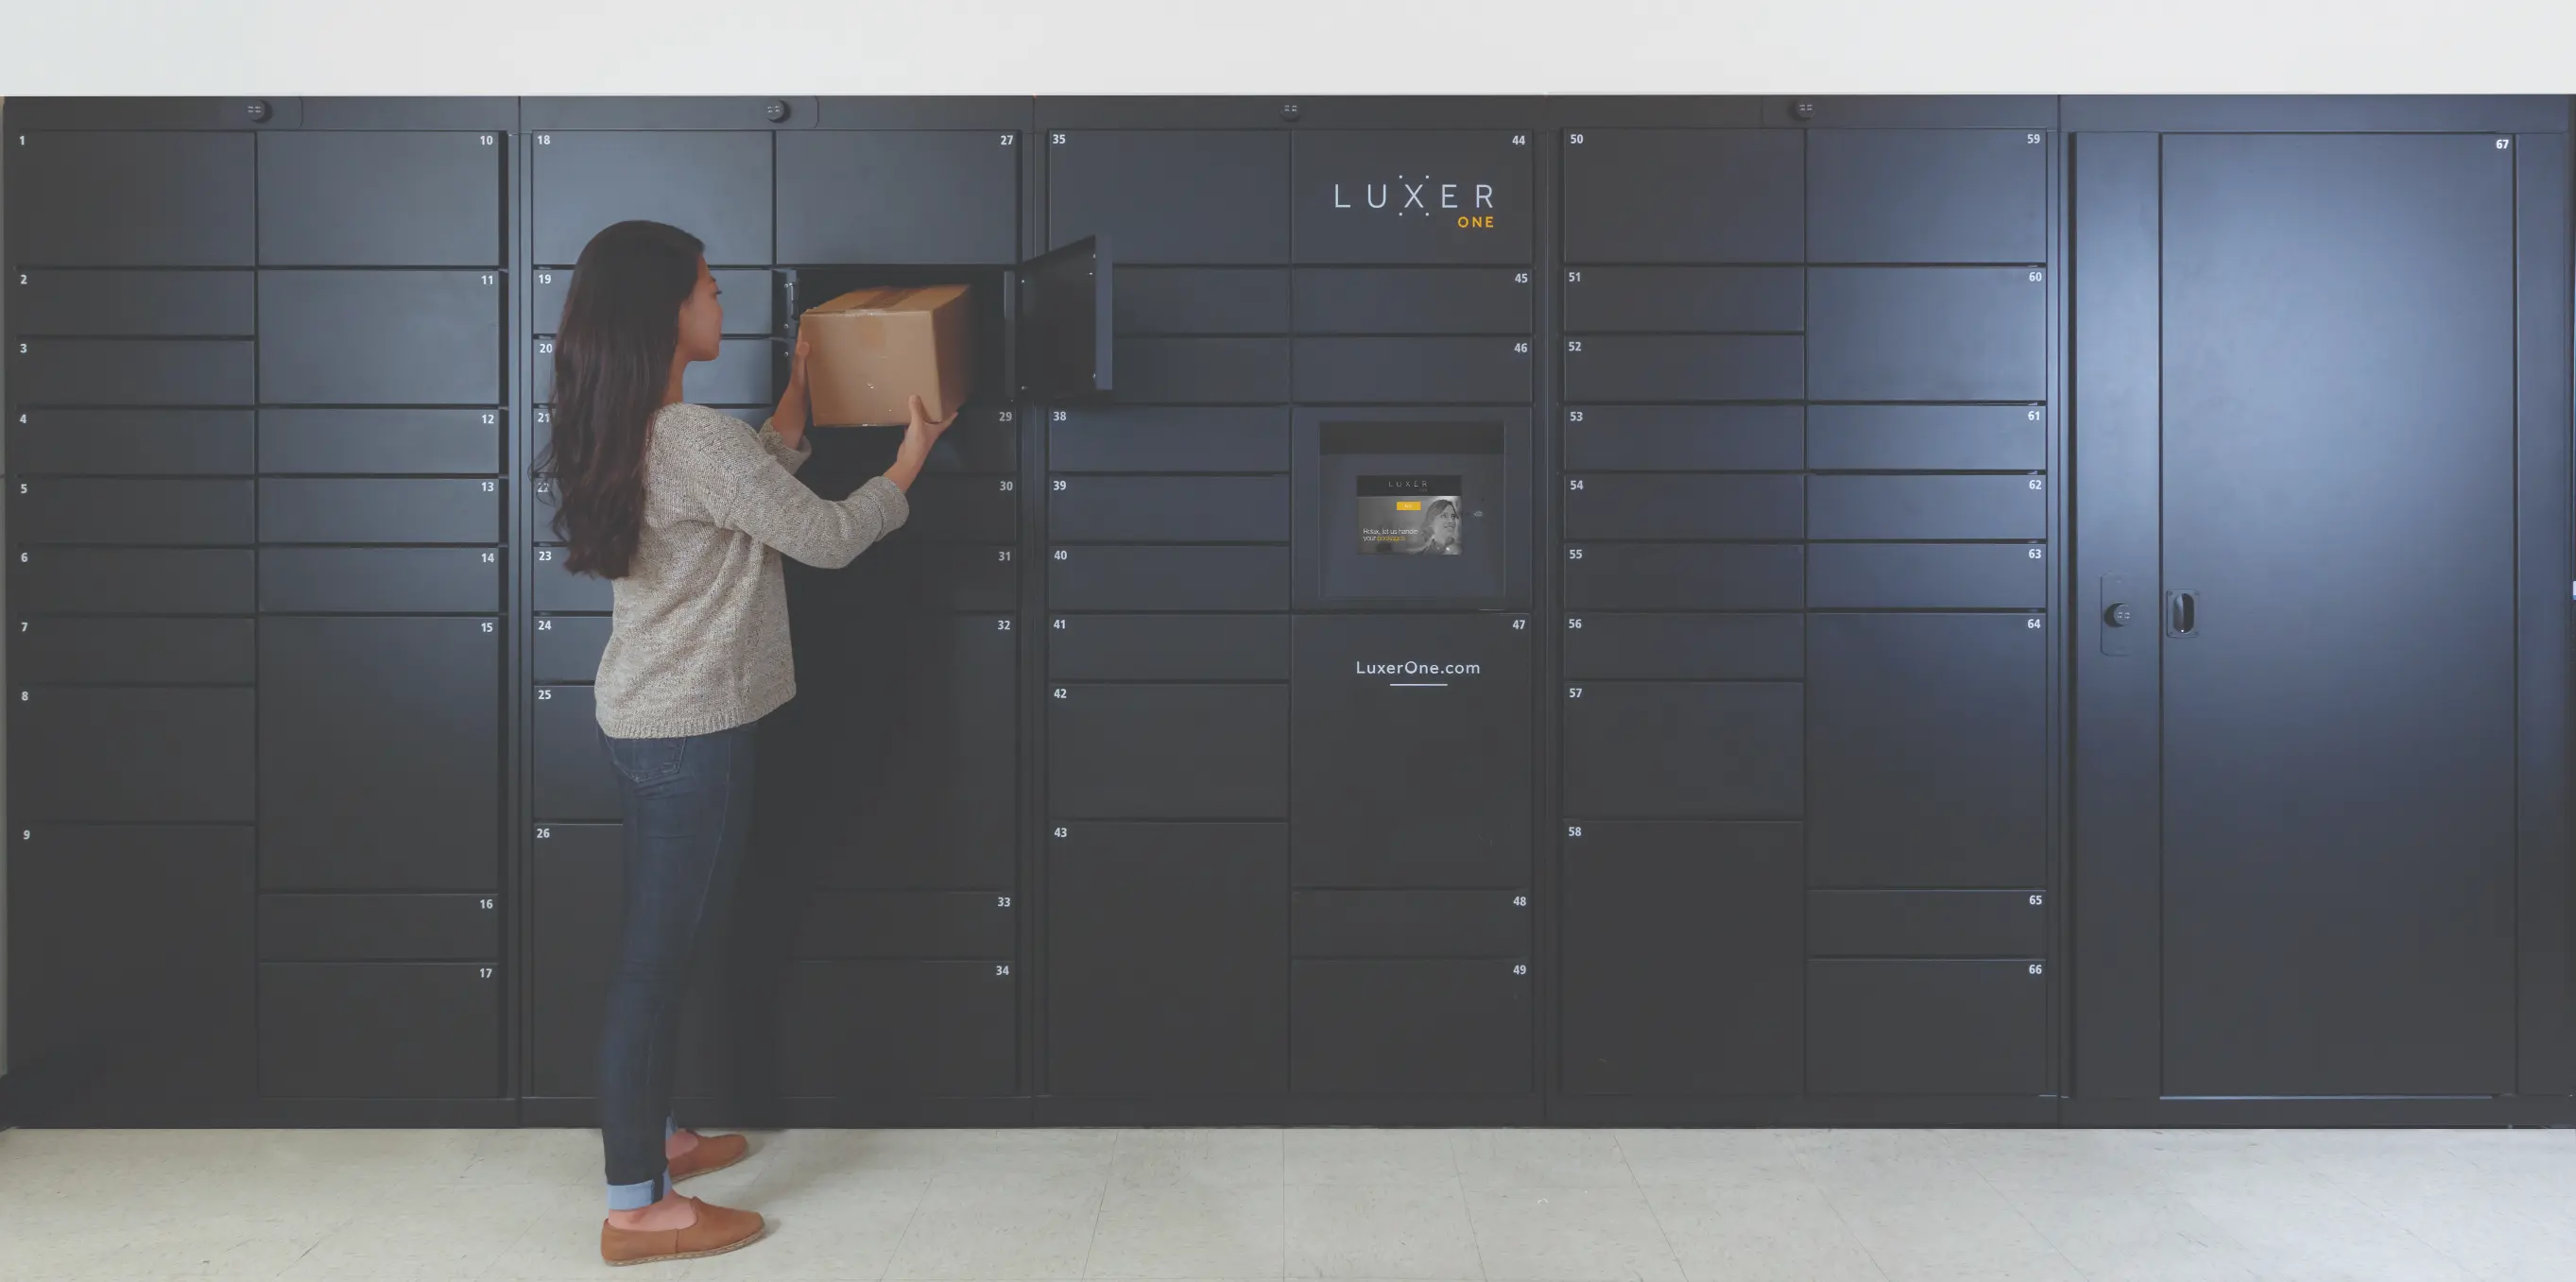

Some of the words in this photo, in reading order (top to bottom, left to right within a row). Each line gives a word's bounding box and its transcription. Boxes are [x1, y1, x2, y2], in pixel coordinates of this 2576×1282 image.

[480, 135, 493, 145] 10
[537, 134, 551, 145] 18
[1000, 134, 1014, 145] 27
[1052, 133, 1066, 145] 35
[1512, 135, 1526, 145] 44
[1570, 133, 1584, 145] 50
[2027, 133, 2041, 145] 59
[2496, 139, 2510, 149] 67
[1334, 183, 1494, 209] LUXER
[1457, 215, 1494, 229] ONE
[20, 274, 27, 285] 2
[481, 274, 493, 285] 11
[538, 274, 552, 284] 19
[1514, 273, 1528, 283] 45
[1569, 271, 1581, 282] 51
[2028, 271, 2043, 282] 60
[20, 343, 27, 353] 3
[540, 343, 553, 353] 20
[1514, 342, 1528, 353] 46
[1568, 341, 1582, 352] 52
[19, 414, 27, 424] 4
[481, 414, 494, 424] 12
[537, 412, 550, 423] 21
[999, 411, 1013, 422] 29
[1053, 411, 1067, 421] 38
[1570, 411, 1584, 422] 53
[2027, 410, 2040, 421] 61
[20, 483, 27, 494] 5
[481, 481, 494, 492] 13
[1000, 480, 1014, 491] 30
[1053, 480, 1067, 491] 39
[1570, 479, 1584, 490] 54
[2029, 479, 2042, 490] 62
[21, 552, 28, 563] 6
[481, 553, 495, 563] 14
[539, 551, 552, 561] 23
[998, 551, 1011, 561] 31
[1054, 550, 1068, 560] 40
[1569, 549, 1583, 559] 55
[2028, 548, 2042, 559] 63
[21, 622, 28, 632] 7
[481, 622, 493, 633] 15
[538, 620, 552, 631] 24
[997, 620, 1011, 630] 32
[1053, 619, 1066, 629] 41
[1512, 619, 1526, 630] 47
[1568, 618, 1582, 629] 56
[2027, 618, 2041, 629] 64
[1356, 660, 1481, 675] LuxerOne.com
[21, 691, 29, 702] 8
[538, 689, 552, 700] 25
[1054, 688, 1067, 699] 42
[1569, 688, 1583, 698] 57
[23, 829, 31, 840] 9
[536, 828, 551, 839] 26
[1054, 827, 1068, 838] 43
[1568, 826, 1582, 837] 58
[479, 898, 493, 910] 16
[997, 897, 1011, 908] 33
[1513, 896, 1527, 907] 48
[2029, 895, 2043, 905] 65
[479, 967, 492, 979] 17
[996, 965, 1010, 976] 34
[1513, 965, 1527, 975] 49
[2028, 964, 2042, 975] 66
